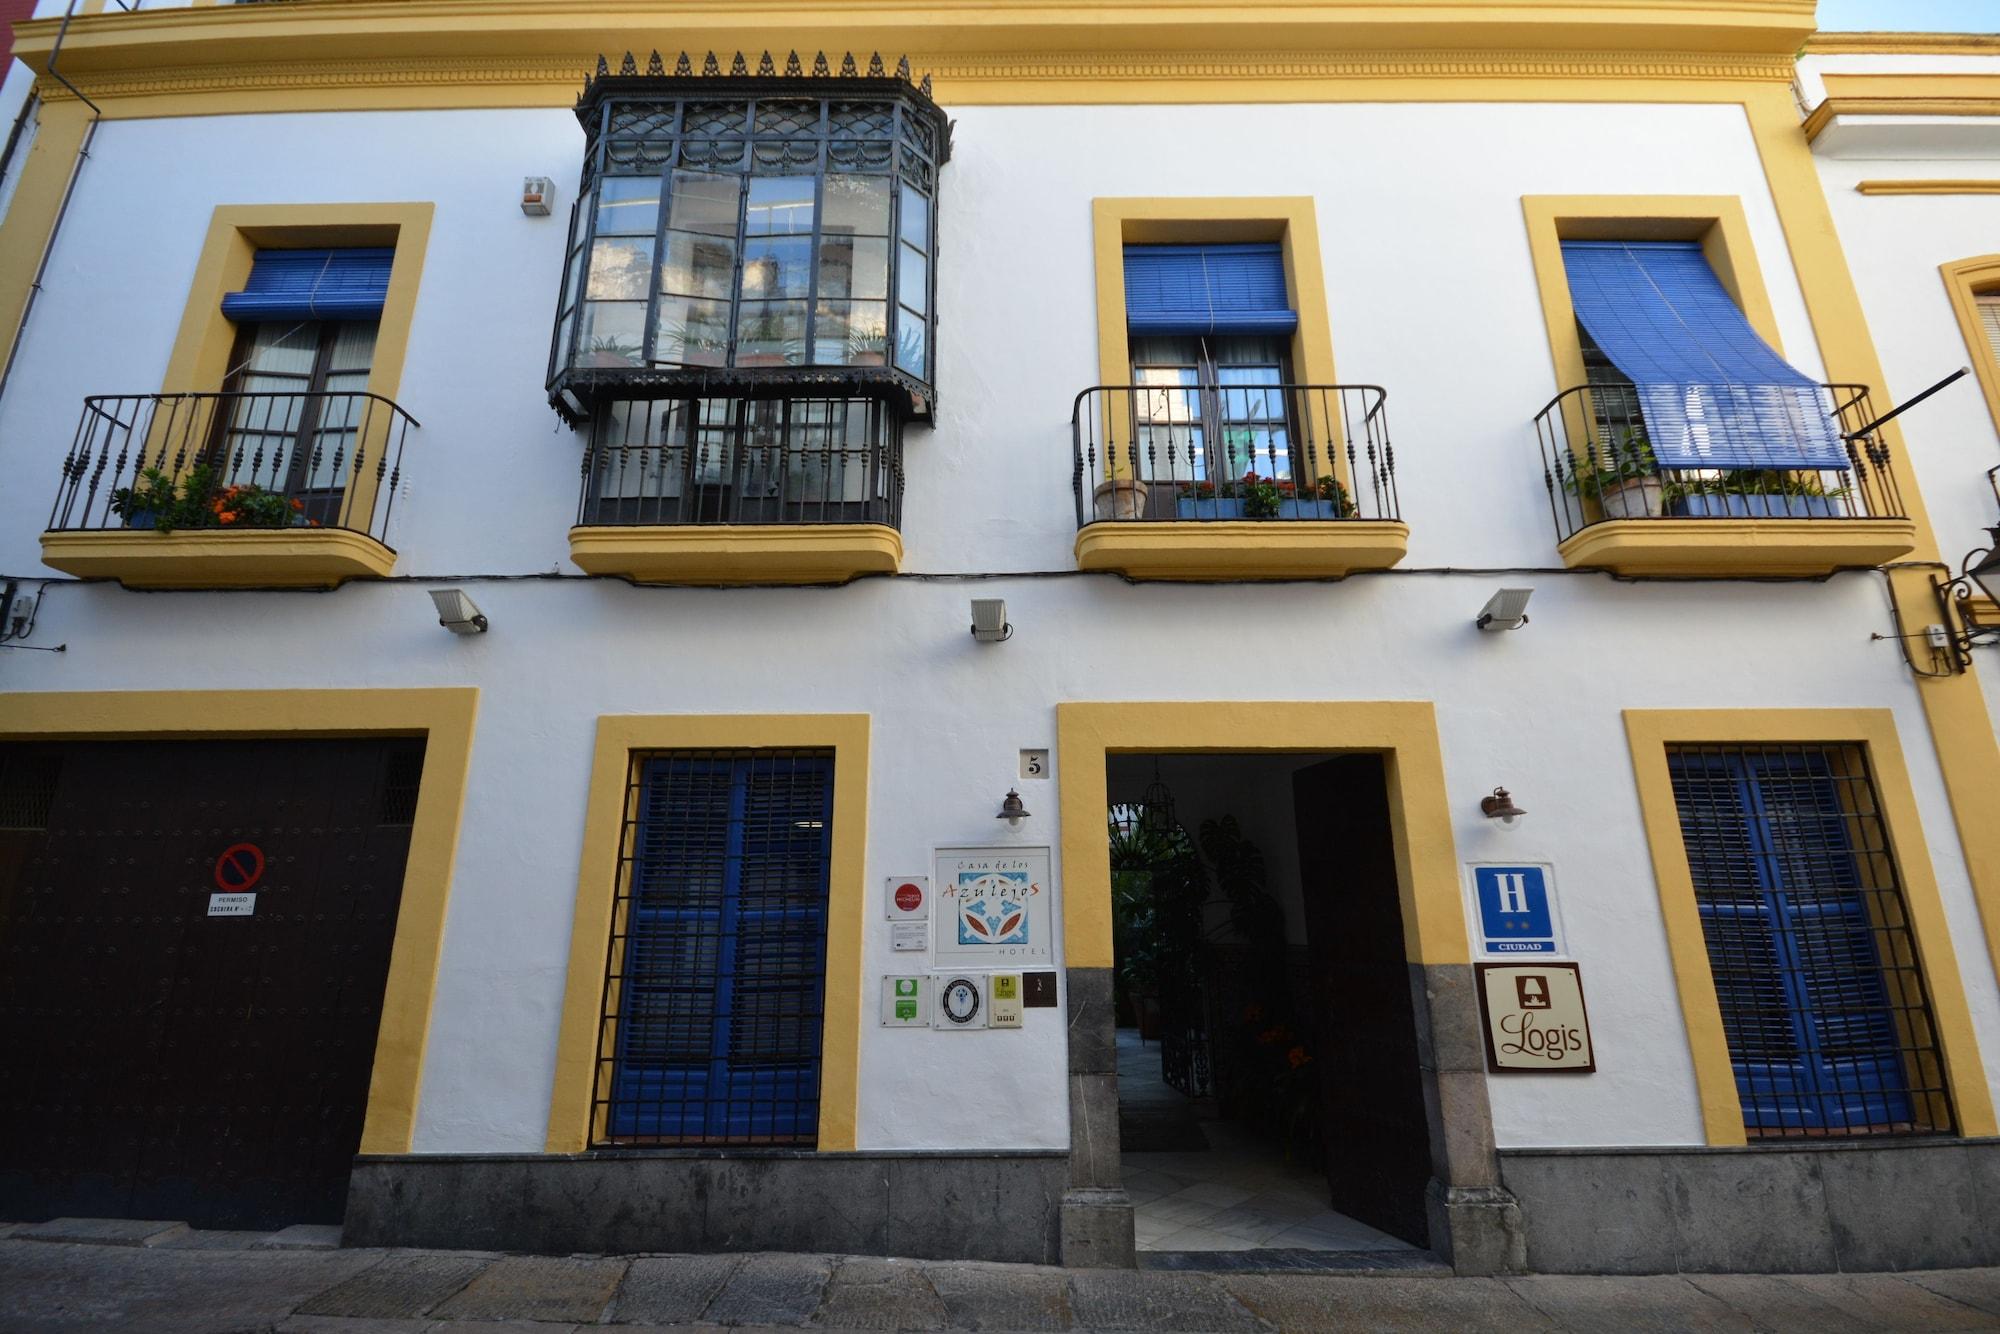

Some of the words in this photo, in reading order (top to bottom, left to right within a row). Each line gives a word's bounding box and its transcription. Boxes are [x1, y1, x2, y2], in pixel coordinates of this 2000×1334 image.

[1028, 754, 1041, 775] 5
[957, 860, 989, 870] Casa
[995, 860, 1007, 872] de
[1011, 860, 1029, 870] los
[1494, 873, 1531, 913] H
[999, 947, 1046, 956] HOTEL
[1498, 943, 1542, 951] CIUDAD
[1500, 1011, 1582, 1061] Logis
